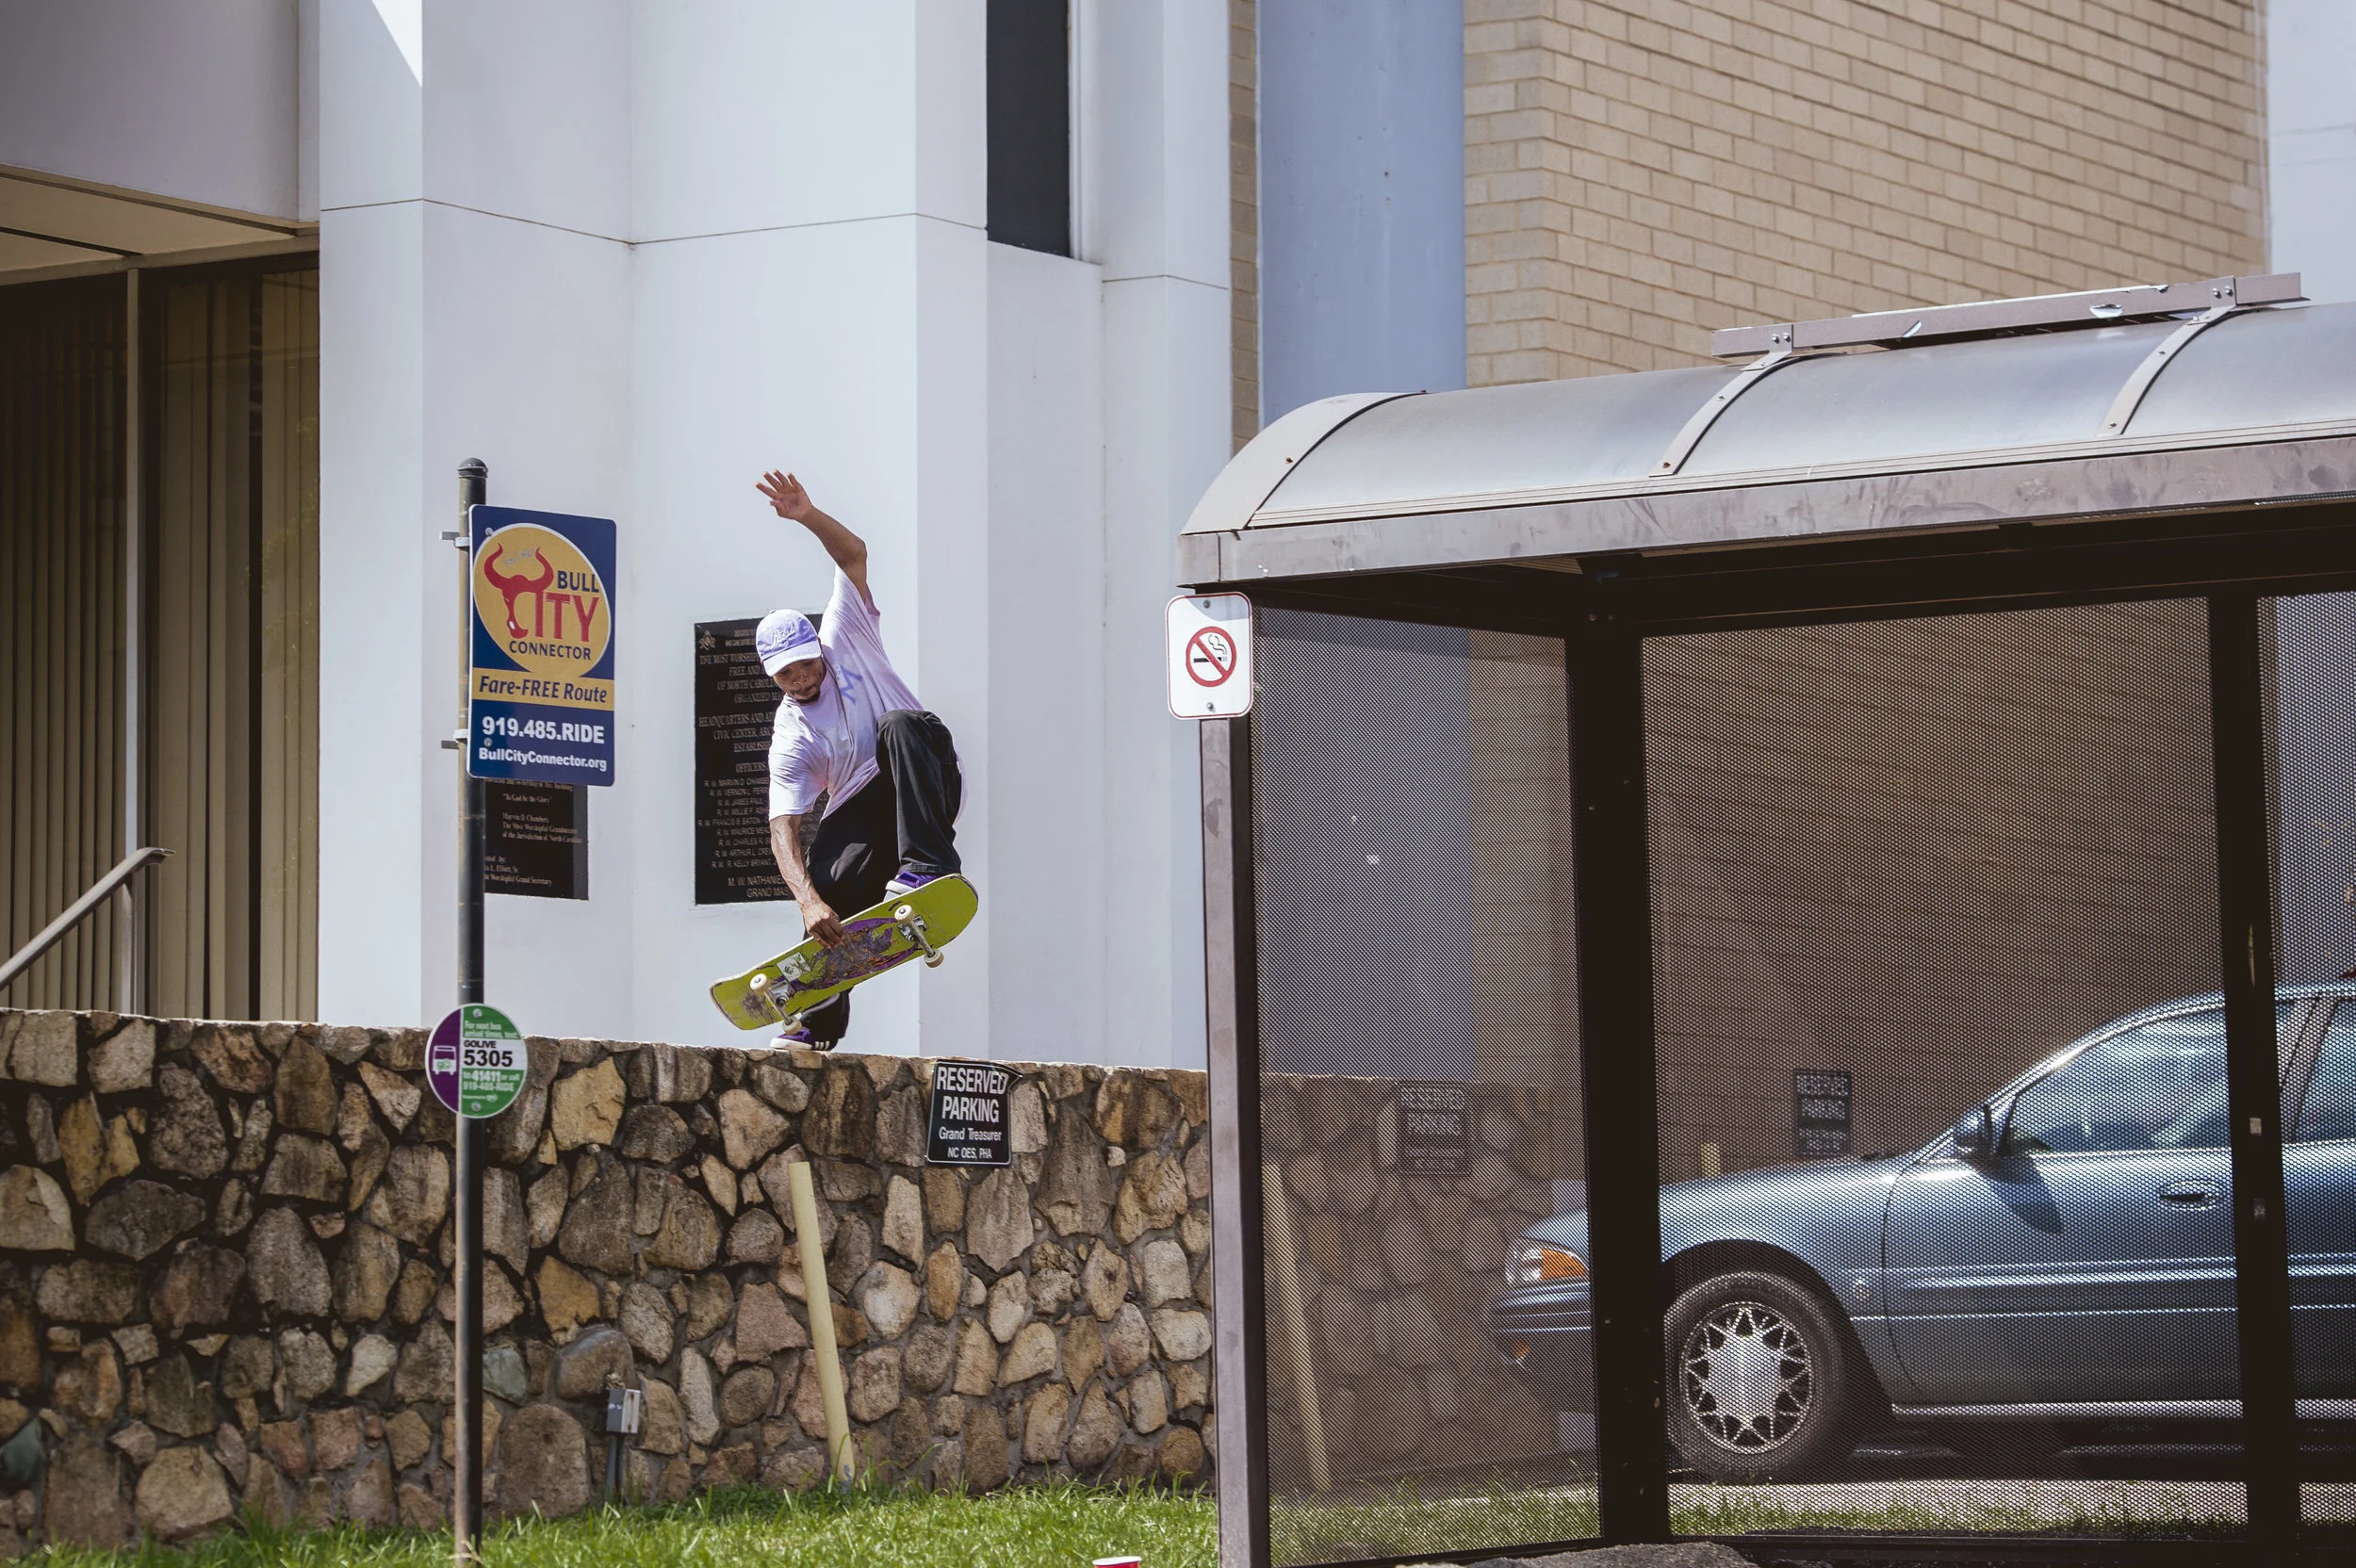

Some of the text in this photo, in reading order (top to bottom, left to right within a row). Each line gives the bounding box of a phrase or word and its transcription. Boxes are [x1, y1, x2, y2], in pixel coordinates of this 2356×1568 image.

[557, 570, 599, 593] BULL
[509, 640, 592, 661] CONNECTOR
[479, 675, 608, 703] Fare-FREE Route
[483, 716, 605, 743] 919.485.RIDE
[479, 746, 608, 772] BullCityConnector.org
[464, 1039, 497, 1049] GOLIVE
[464, 1049, 513, 1067] 5305
[463, 1082, 515, 1091] 919-485-RIDE
[472, 1070, 501, 1082] 41411
[937, 1066, 1009, 1095] RESERVED
[941, 1095, 999, 1123] PARKING
[939, 1126, 1002, 1141] Grand Treasurer
[947, 1147, 959, 1158] NC
[979, 1147, 992, 1159] PHA
